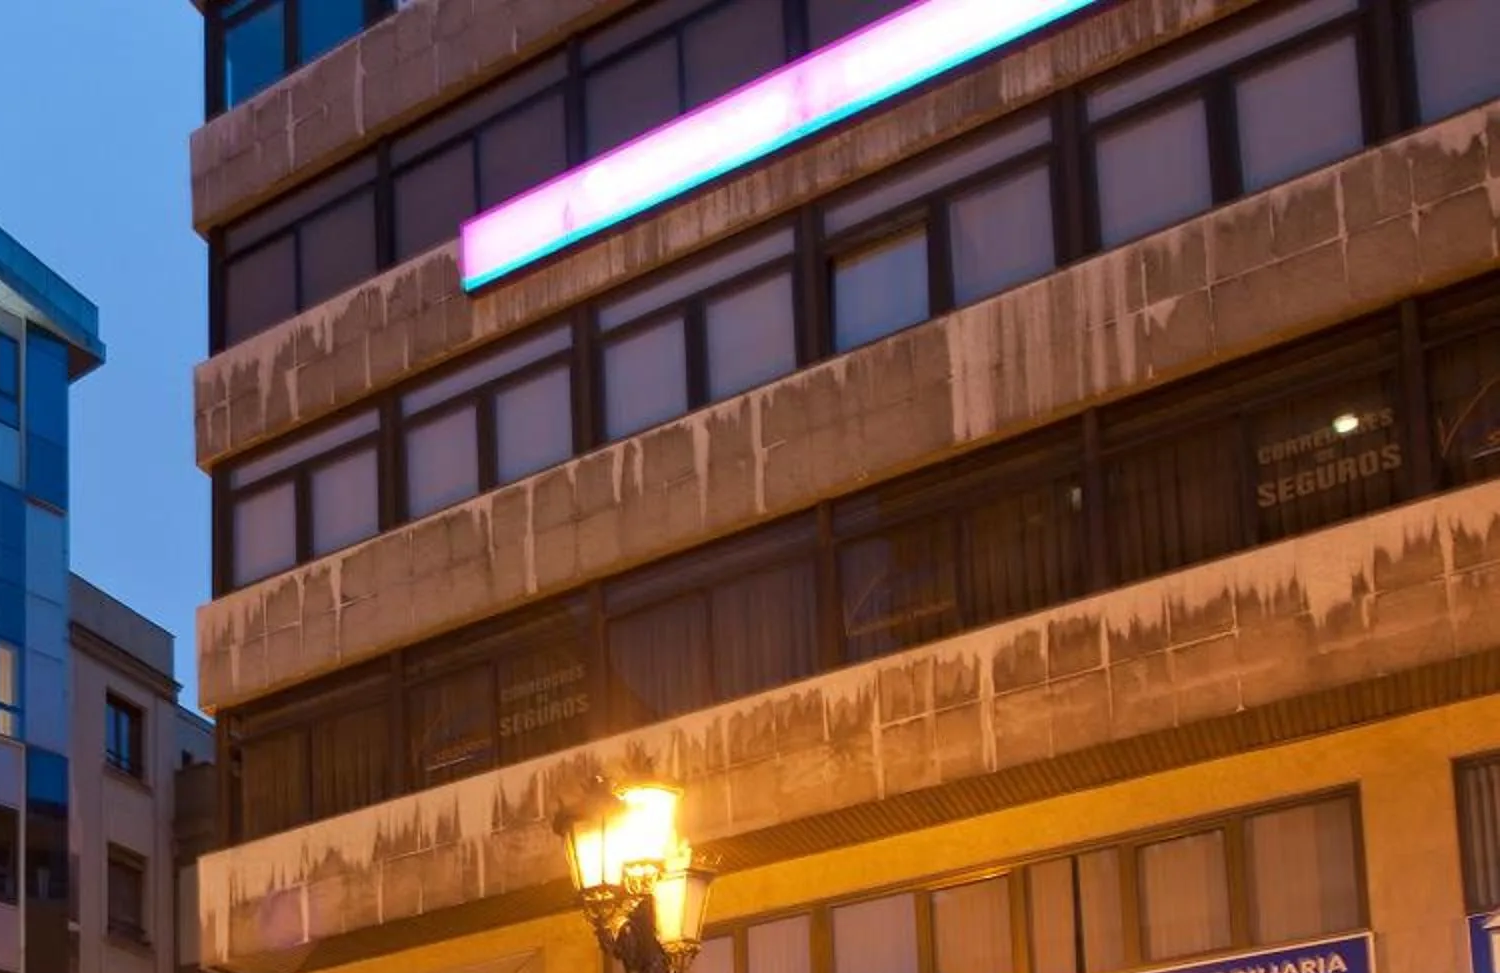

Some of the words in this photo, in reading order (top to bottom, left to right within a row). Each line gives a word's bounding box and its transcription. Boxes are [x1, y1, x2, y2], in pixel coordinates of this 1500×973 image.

[1257, 408, 1393, 465] CORREDRES
[1257, 444, 1402, 507] SEGUROS
[499, 694, 589, 737] SEGUROS
